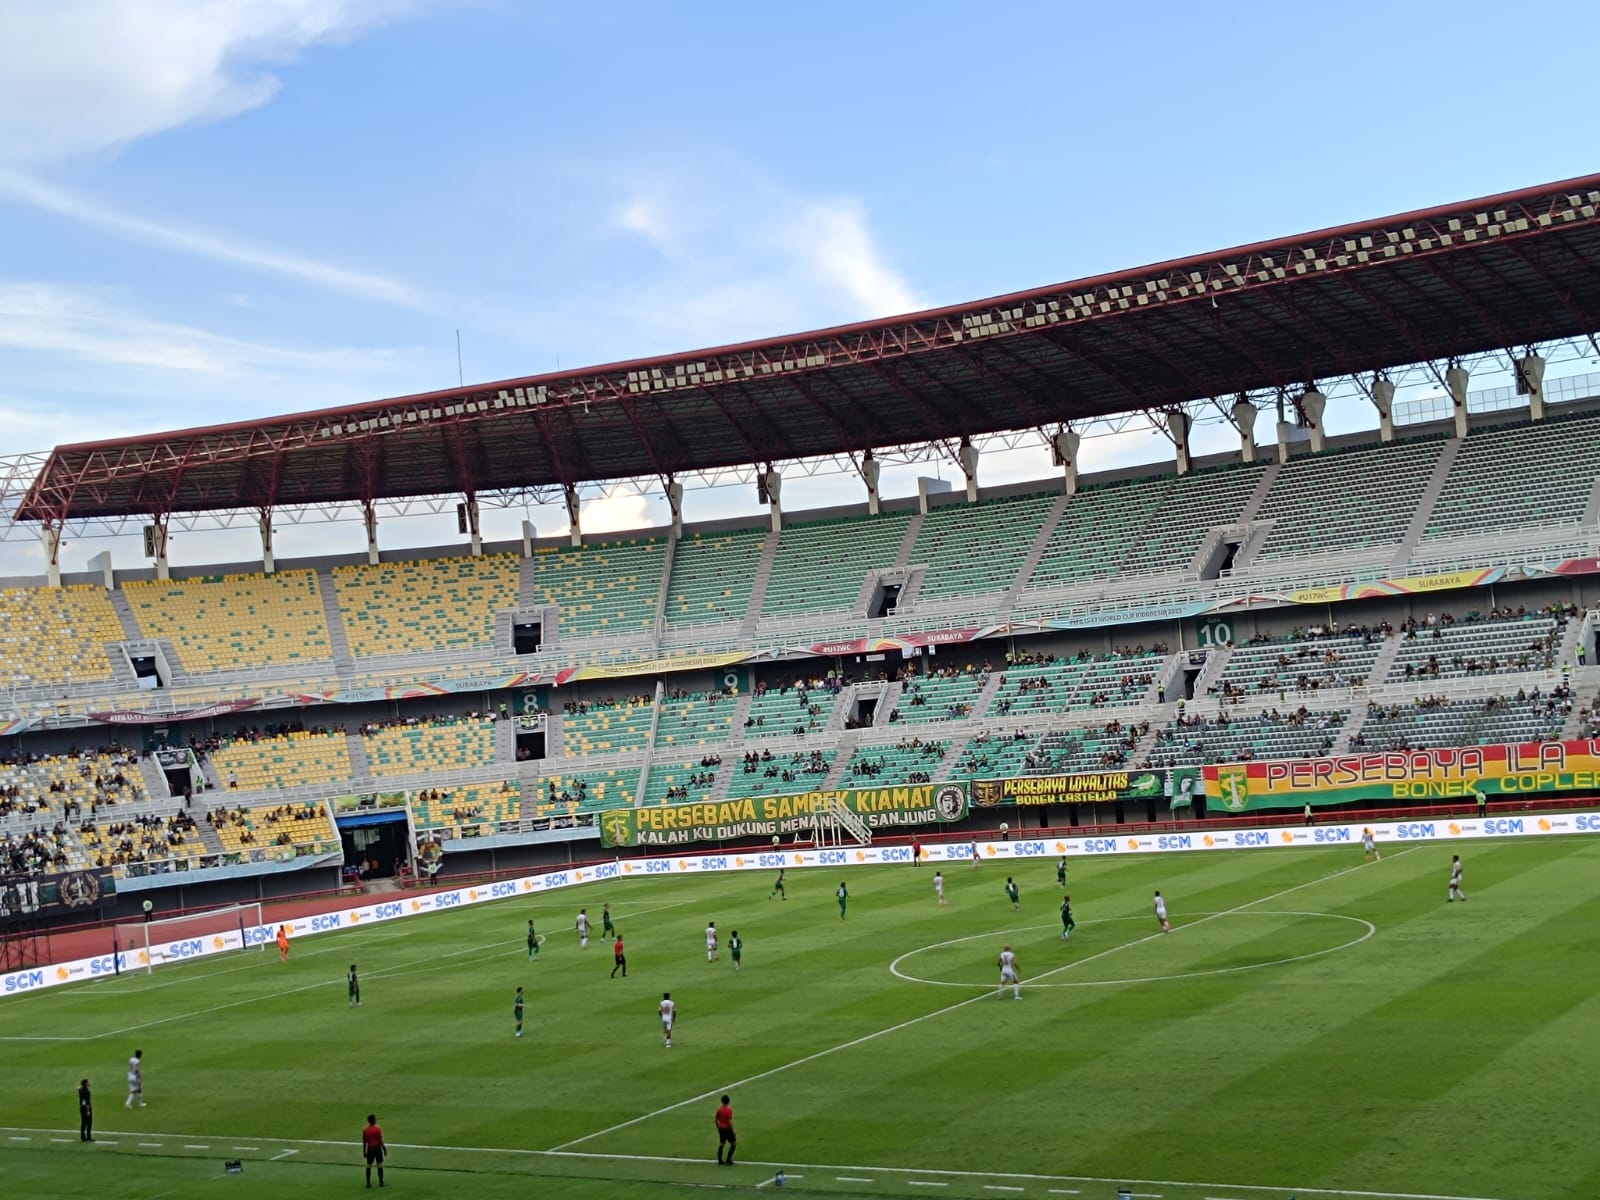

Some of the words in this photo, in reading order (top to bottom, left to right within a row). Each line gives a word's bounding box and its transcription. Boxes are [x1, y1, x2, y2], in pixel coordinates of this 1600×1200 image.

[1418, 577, 1461, 588] SURABAYA
[1098, 614, 1121, 622] WORLD
[1122, 612, 1135, 620] CUP
[1201, 623, 1231, 647] 10
[725, 674, 738, 691] 9
[524, 694, 539, 713] 8
[1266, 747, 1484, 790] PERSEBAYA
[1506, 741, 1566, 772] ILA
[1004, 777, 1067, 796] PERSEBAYA
[1069, 773, 1128, 792] LOYALITAS
[1392, 780, 1479, 798] BONEK
[1059, 790, 1117, 803] CASTELLO
[636, 799, 757, 829] PERSEBAYA
[764, 792, 848, 818] SAMPEK
[856, 786, 934, 811] KIAMAT
[636, 830, 688, 844] KALAH
[693, 827, 712, 840] KU
[717, 821, 777, 839] DUKUNG
[868, 809, 937, 827] SANJUNG
[1397, 824, 1435, 839] SCM
[1484, 819, 1525, 835] SCM
[1158, 835, 1192, 850] SCM
[1234, 831, 1270, 846] SCM
[1314, 828, 1350, 842] SCM
[1014, 842, 1045, 856] SCM
[1084, 839, 1117, 853] SCM
[759, 854, 786, 867] SCM
[819, 851, 847, 864] SCM
[881, 848, 910, 861] SCM
[595, 863, 618, 878] SCM
[646, 860, 671, 873] SCM
[702, 857, 727, 869] SCM
[545, 873, 568, 887] SCM
[491, 882, 516, 897] SCM
[435, 892, 461, 908] SCM
[375, 903, 403, 919] SCM
[311, 914, 341, 931] SCM
[244, 926, 274, 944] SCM
[169, 939, 203, 959] SCM
[5, 970, 43, 991] SCM
